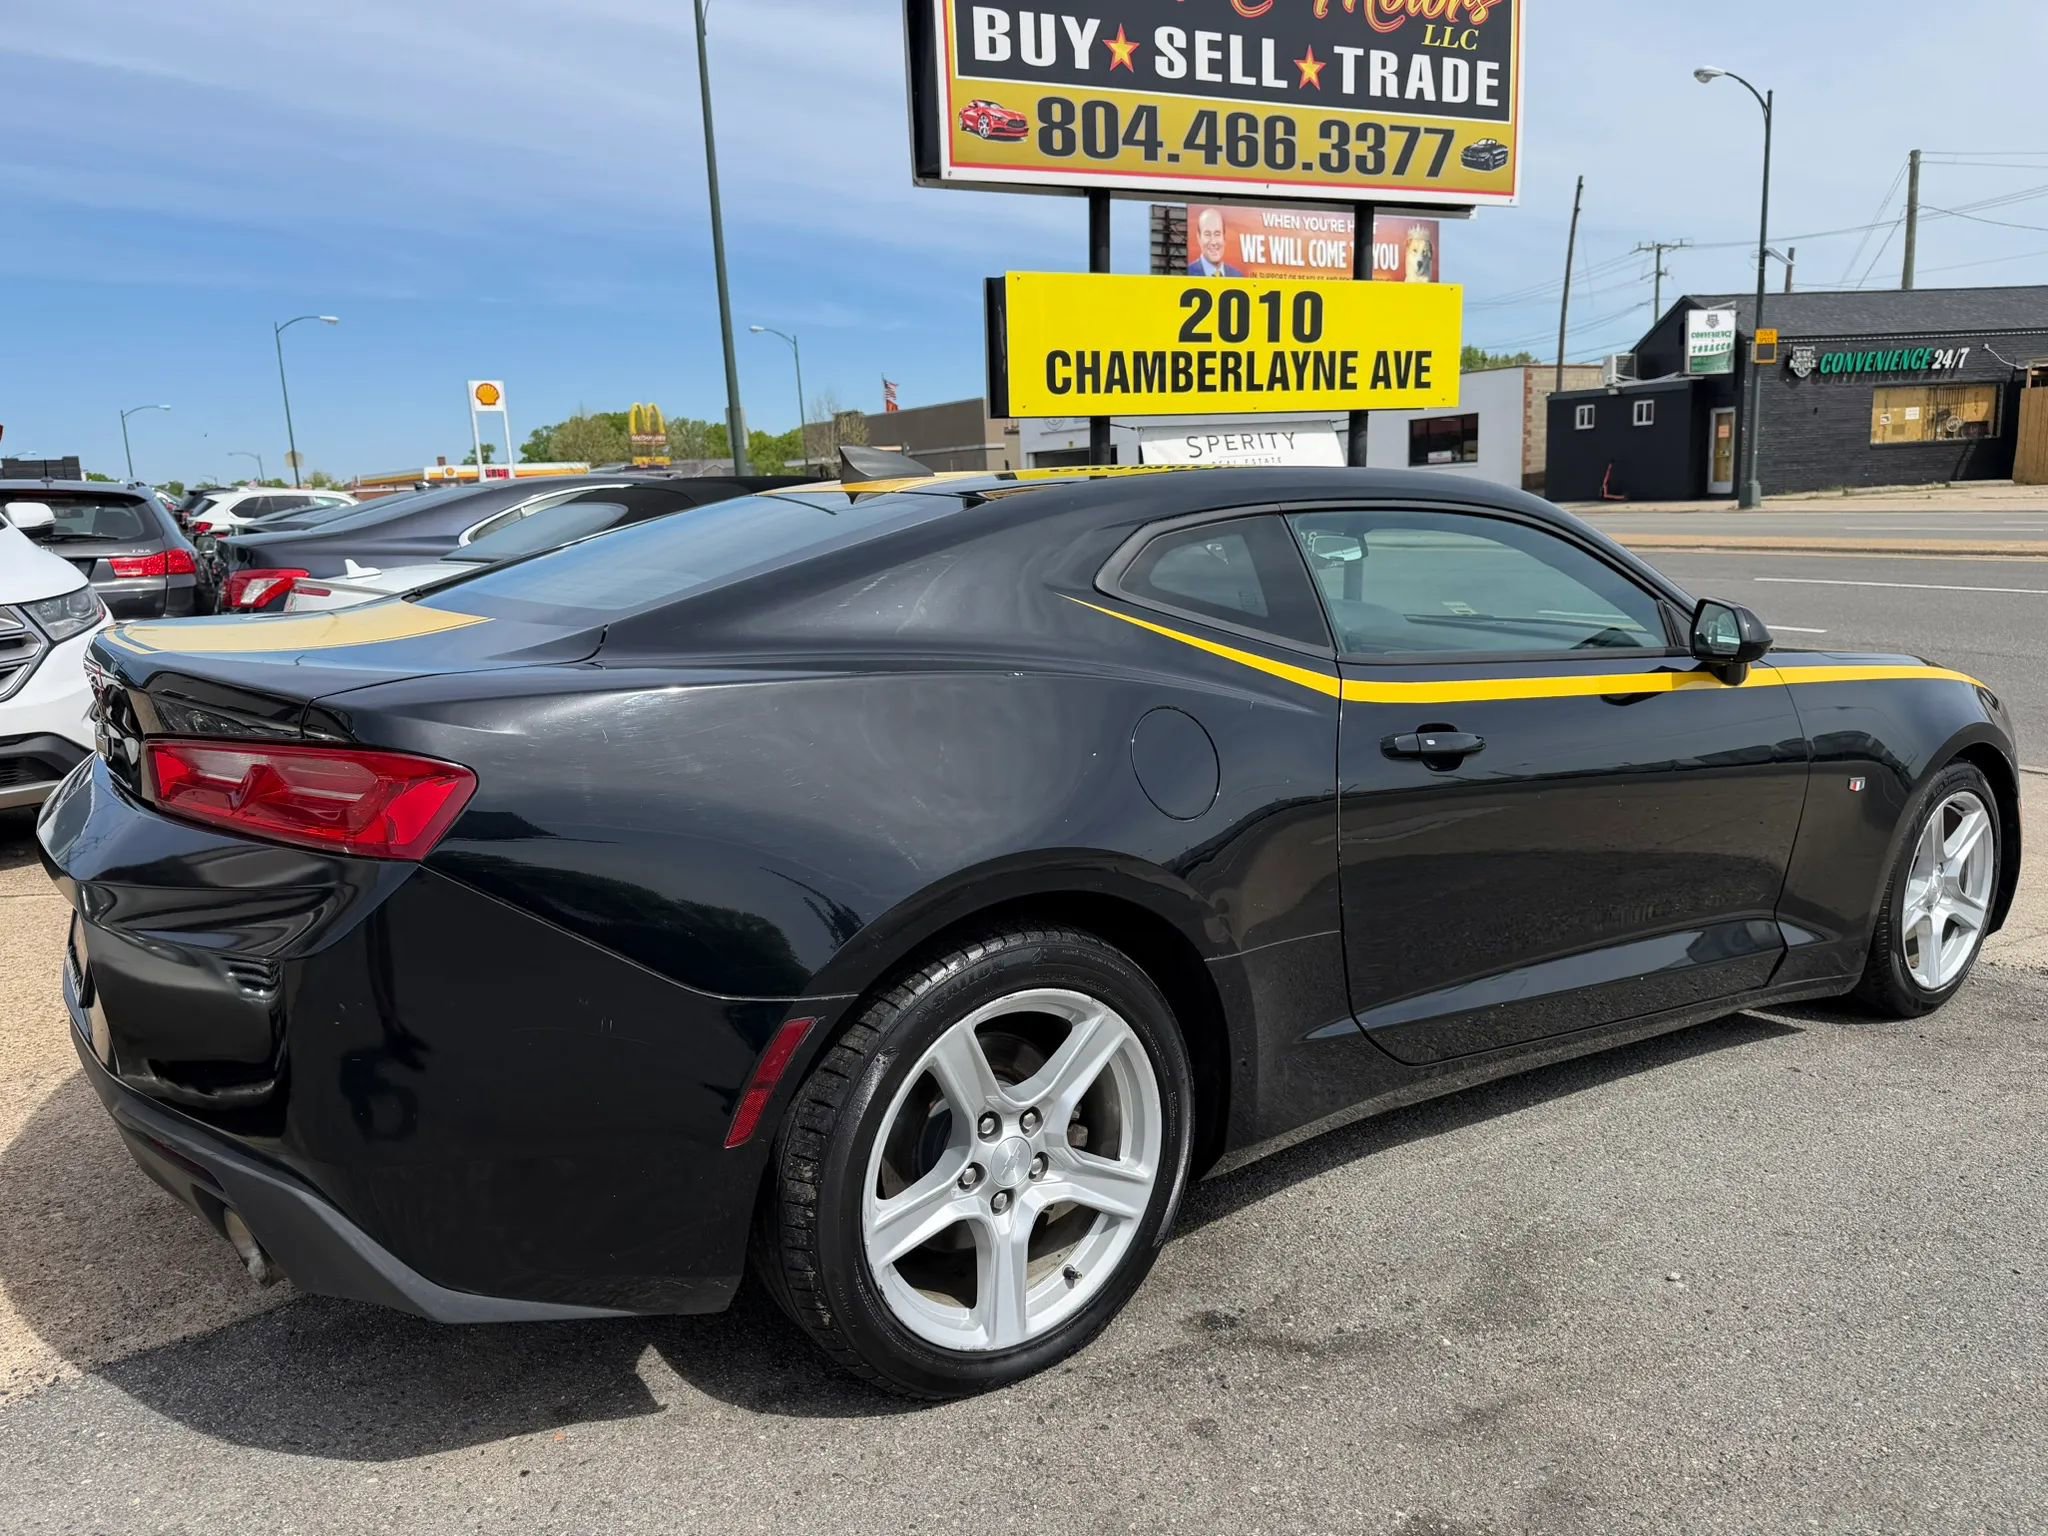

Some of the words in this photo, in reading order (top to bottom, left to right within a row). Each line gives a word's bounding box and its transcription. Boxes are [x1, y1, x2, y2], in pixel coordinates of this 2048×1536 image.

[1421, 23, 1480, 51] LLC
[972, 7, 1101, 71] BUY
[1153, 25, 1289, 90] SELL
[1332, 45, 1500, 107] TRADE
[1036, 95, 1456, 179] 804.466.3377
[1261, 212, 1300, 230] WHEN
[1302, 216, 1346, 234] YOU'RE
[1239, 233, 1266, 264] WE
[1268, 235, 1305, 267] WILL
[1308, 239, 1347, 269] COME
[1372, 242, 1399, 271] YOU
[1178, 288, 1324, 344] 2010
[1692, 342, 1732, 354] TOBACCO
[1819, 347, 1935, 374] CONVENIENCE
[1931, 347, 1971, 370] 24/7
[1045, 349, 1358, 396] CHAMBERLAYNE
[1370, 350, 1433, 390] AVE
[1185, 431, 1297, 459] SPERITY
